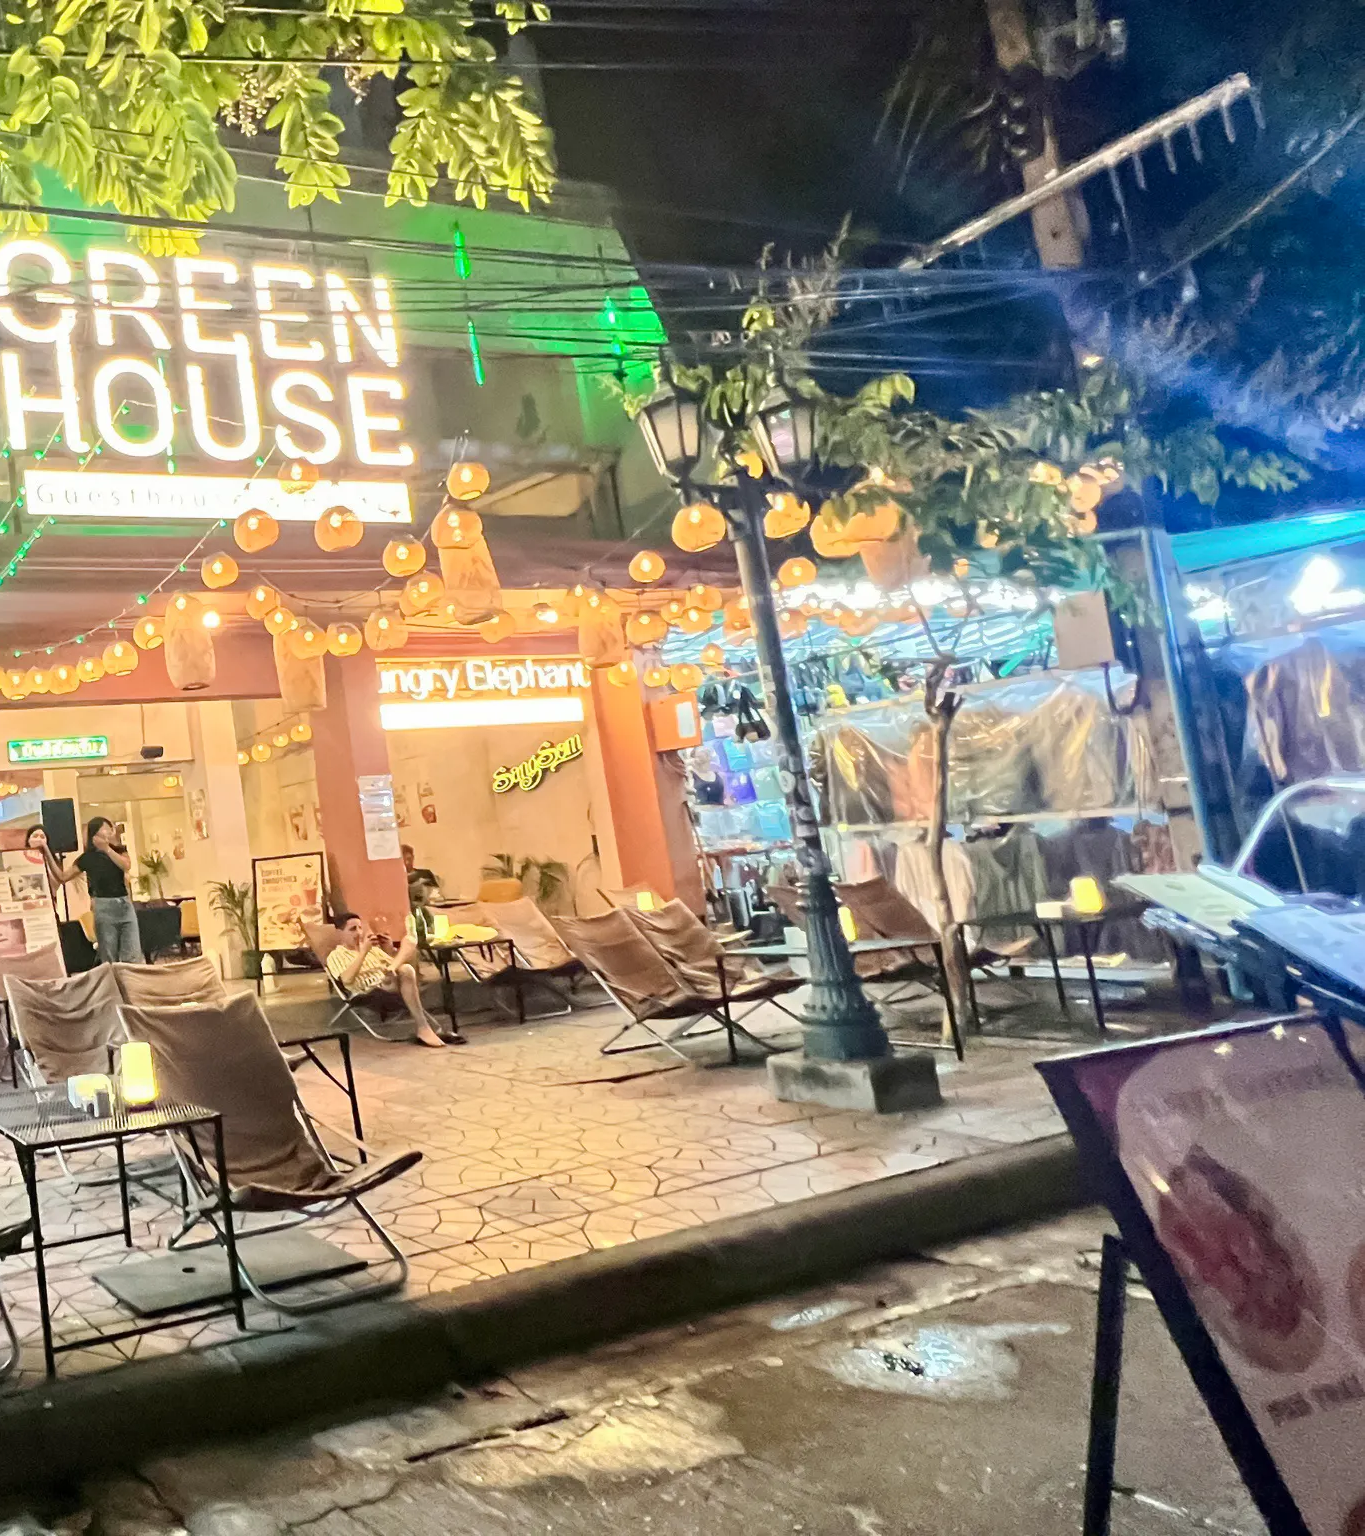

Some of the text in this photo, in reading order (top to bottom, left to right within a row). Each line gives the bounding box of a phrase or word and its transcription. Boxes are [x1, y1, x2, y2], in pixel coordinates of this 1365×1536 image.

[1, 334, 414, 466] HOUSE
[36, 481, 244, 511] Guesthou
[465, 659, 591, 696] Elephant
